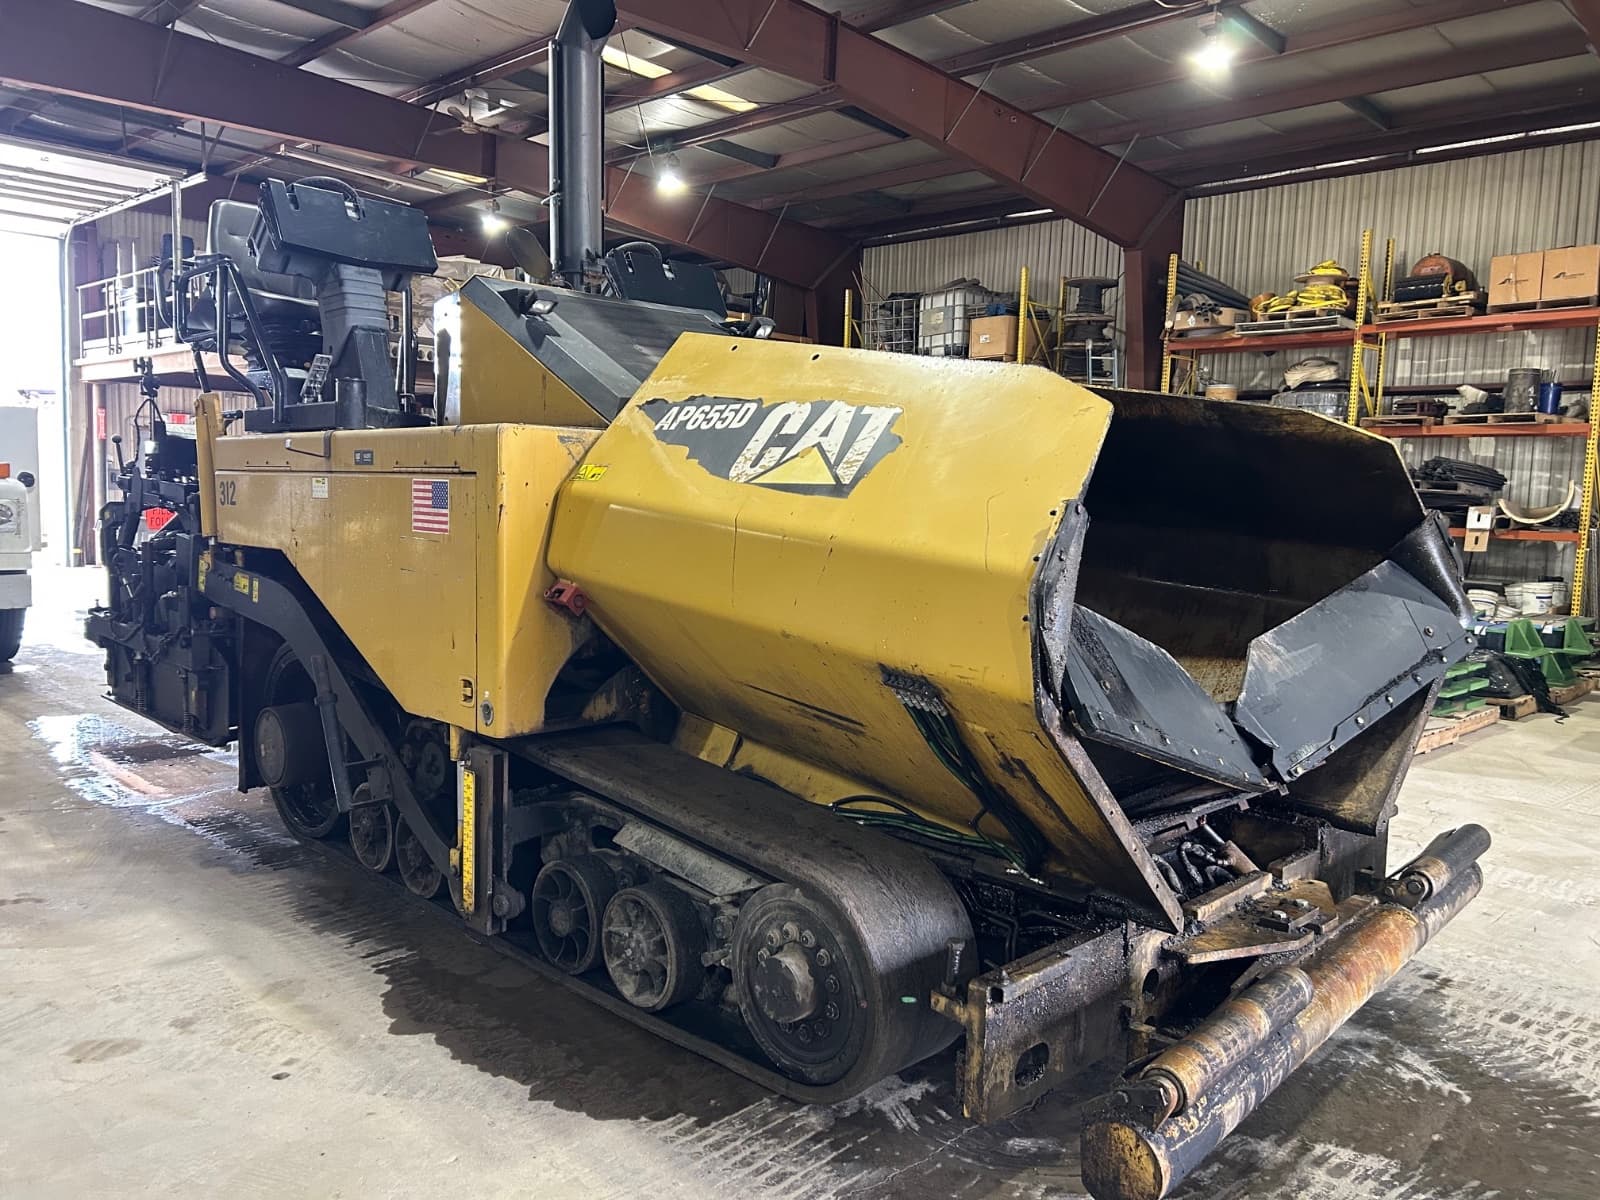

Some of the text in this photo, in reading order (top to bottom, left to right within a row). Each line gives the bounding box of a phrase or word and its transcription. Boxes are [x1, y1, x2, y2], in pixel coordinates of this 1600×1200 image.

[655, 402, 758, 430] AP655D
[728, 400, 903, 485] CAT
[220, 481, 236, 505] 312
